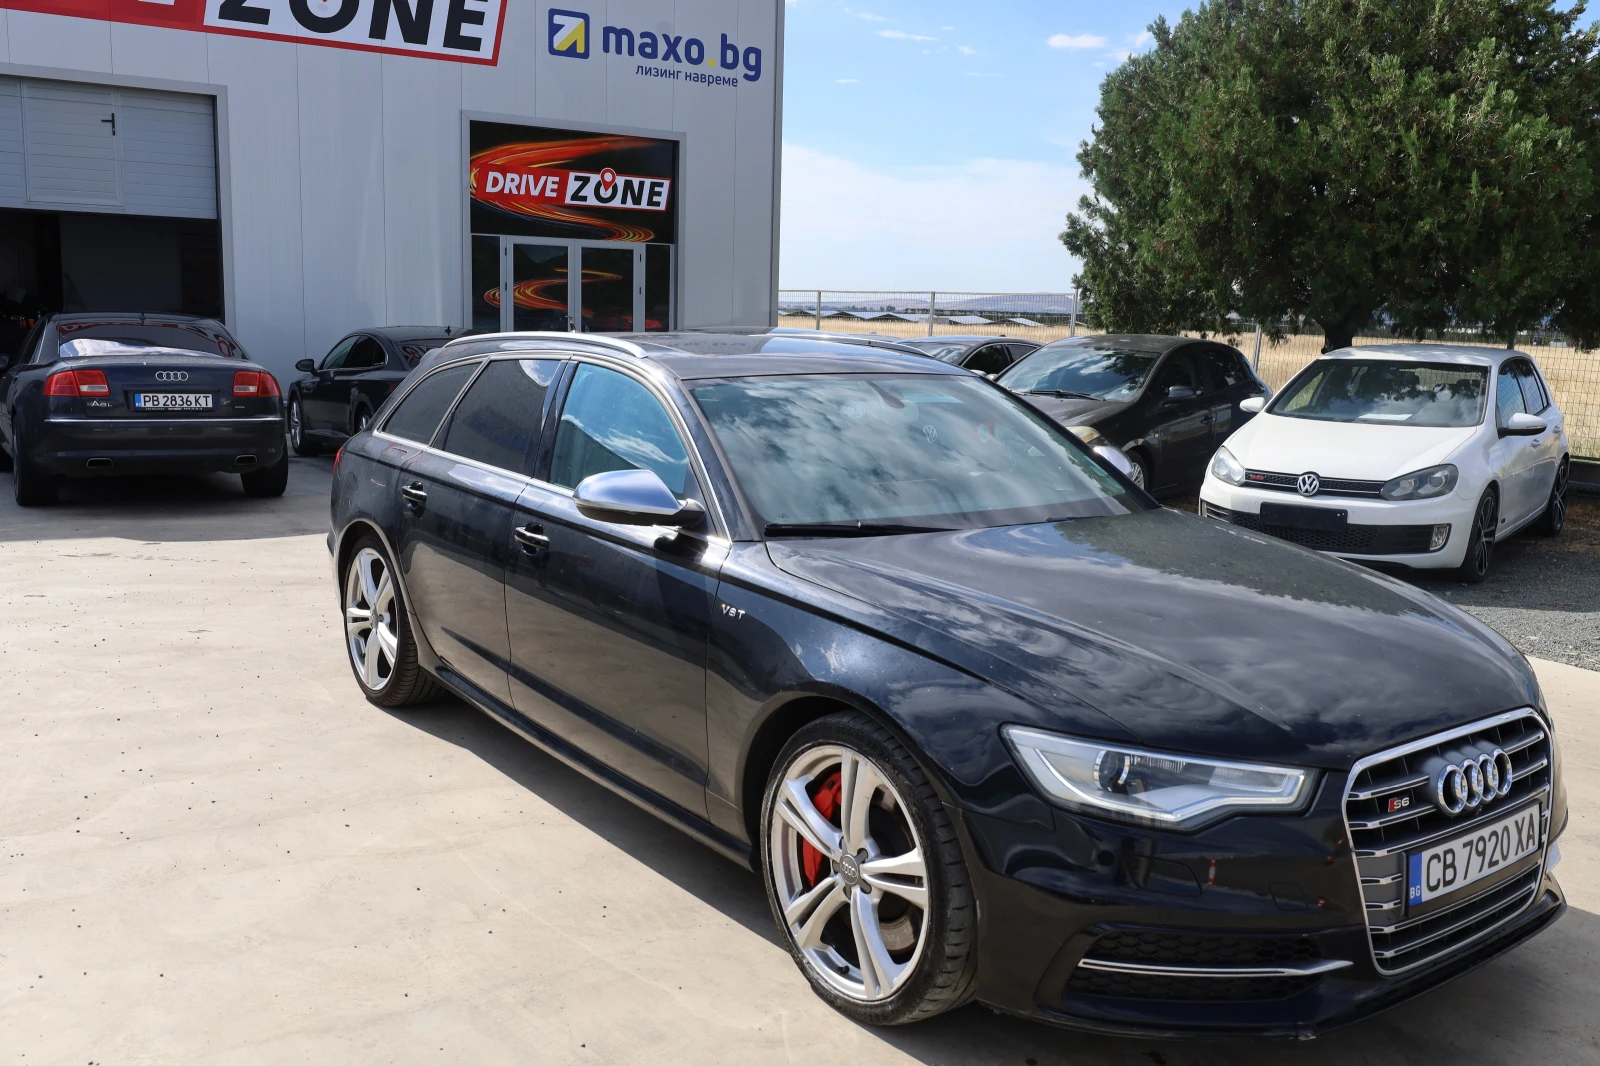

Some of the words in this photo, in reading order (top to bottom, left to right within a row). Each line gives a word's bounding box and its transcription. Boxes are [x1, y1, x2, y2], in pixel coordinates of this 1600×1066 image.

[602, 25, 762, 82] maxo.bg
[635, 65, 682, 80] лизинг
[684, 72, 739, 87] навреме
[485, 171, 560, 198] DRIVE
[570, 174, 665, 208] ZONE
[143, 395, 160, 407] PB
[162, 395, 193, 407] 2836
[194, 395, 211, 407] KT
[722, 603, 746, 620] V8T
[1393, 797, 1410, 810] S6
[1426, 848, 1457, 893] CB
[1462, 825, 1511, 881] 7920
[1514, 812, 1536, 857] XA
[1409, 884, 1421, 899] BG
